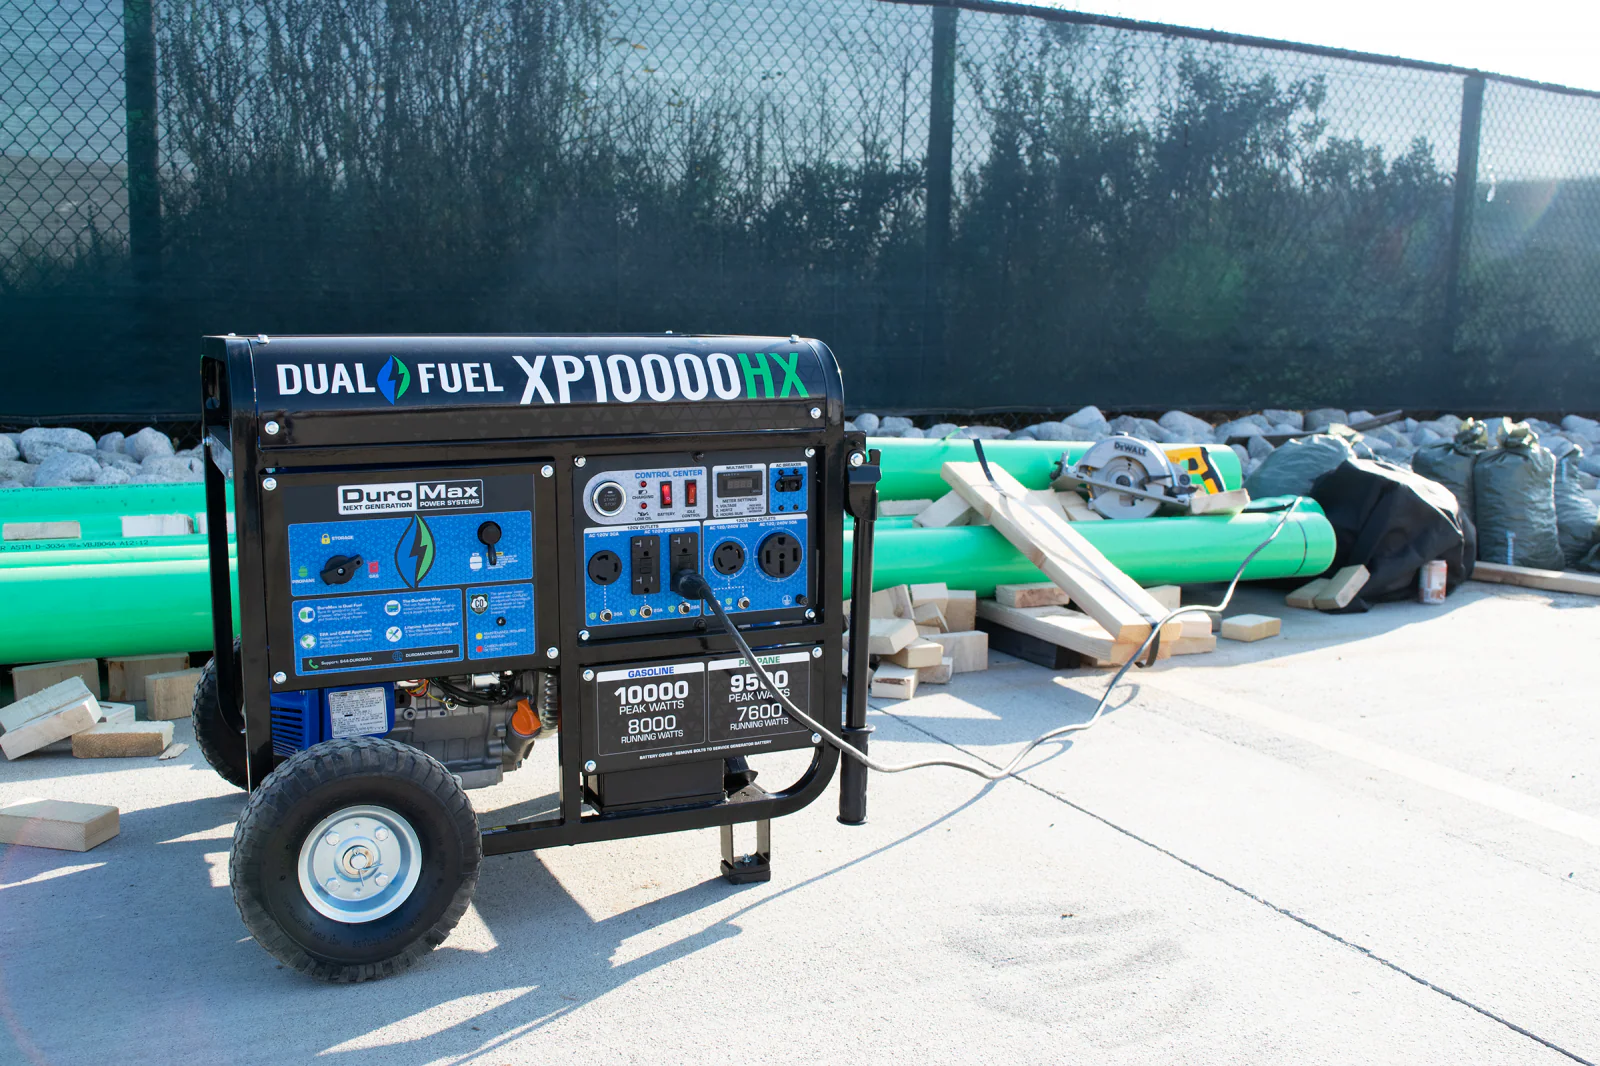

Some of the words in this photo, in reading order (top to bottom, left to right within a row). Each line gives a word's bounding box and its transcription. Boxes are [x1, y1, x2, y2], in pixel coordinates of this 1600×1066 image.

[276, 362, 375, 395] DUAL
[418, 362, 504, 393] FUEL
[512, 352, 810, 405] XP10000HX
[634, 471, 671, 479] CONTROL
[672, 469, 703, 477] CENTER
[365, 502, 412, 510] GENERATION
[447, 498, 480, 506] SYSTEMS
[738, 656, 781, 667] PRPANE
[628, 666, 674, 678] GASOLINE
[614, 680, 689, 705] 10000
[728, 691, 755, 703] PEAK
[756, 688, 790, 700] WAS
[619, 703, 647, 715] PEAK
[648, 700, 685, 712] WATTS
[736, 702, 782, 722] 7600
[628, 714, 677, 734] 8000
[729, 720, 763, 731] RUNNING
[764, 717, 789, 727] WATTS
[621, 732, 657, 744] RUNNING
[657, 729, 684, 740] WATTS
